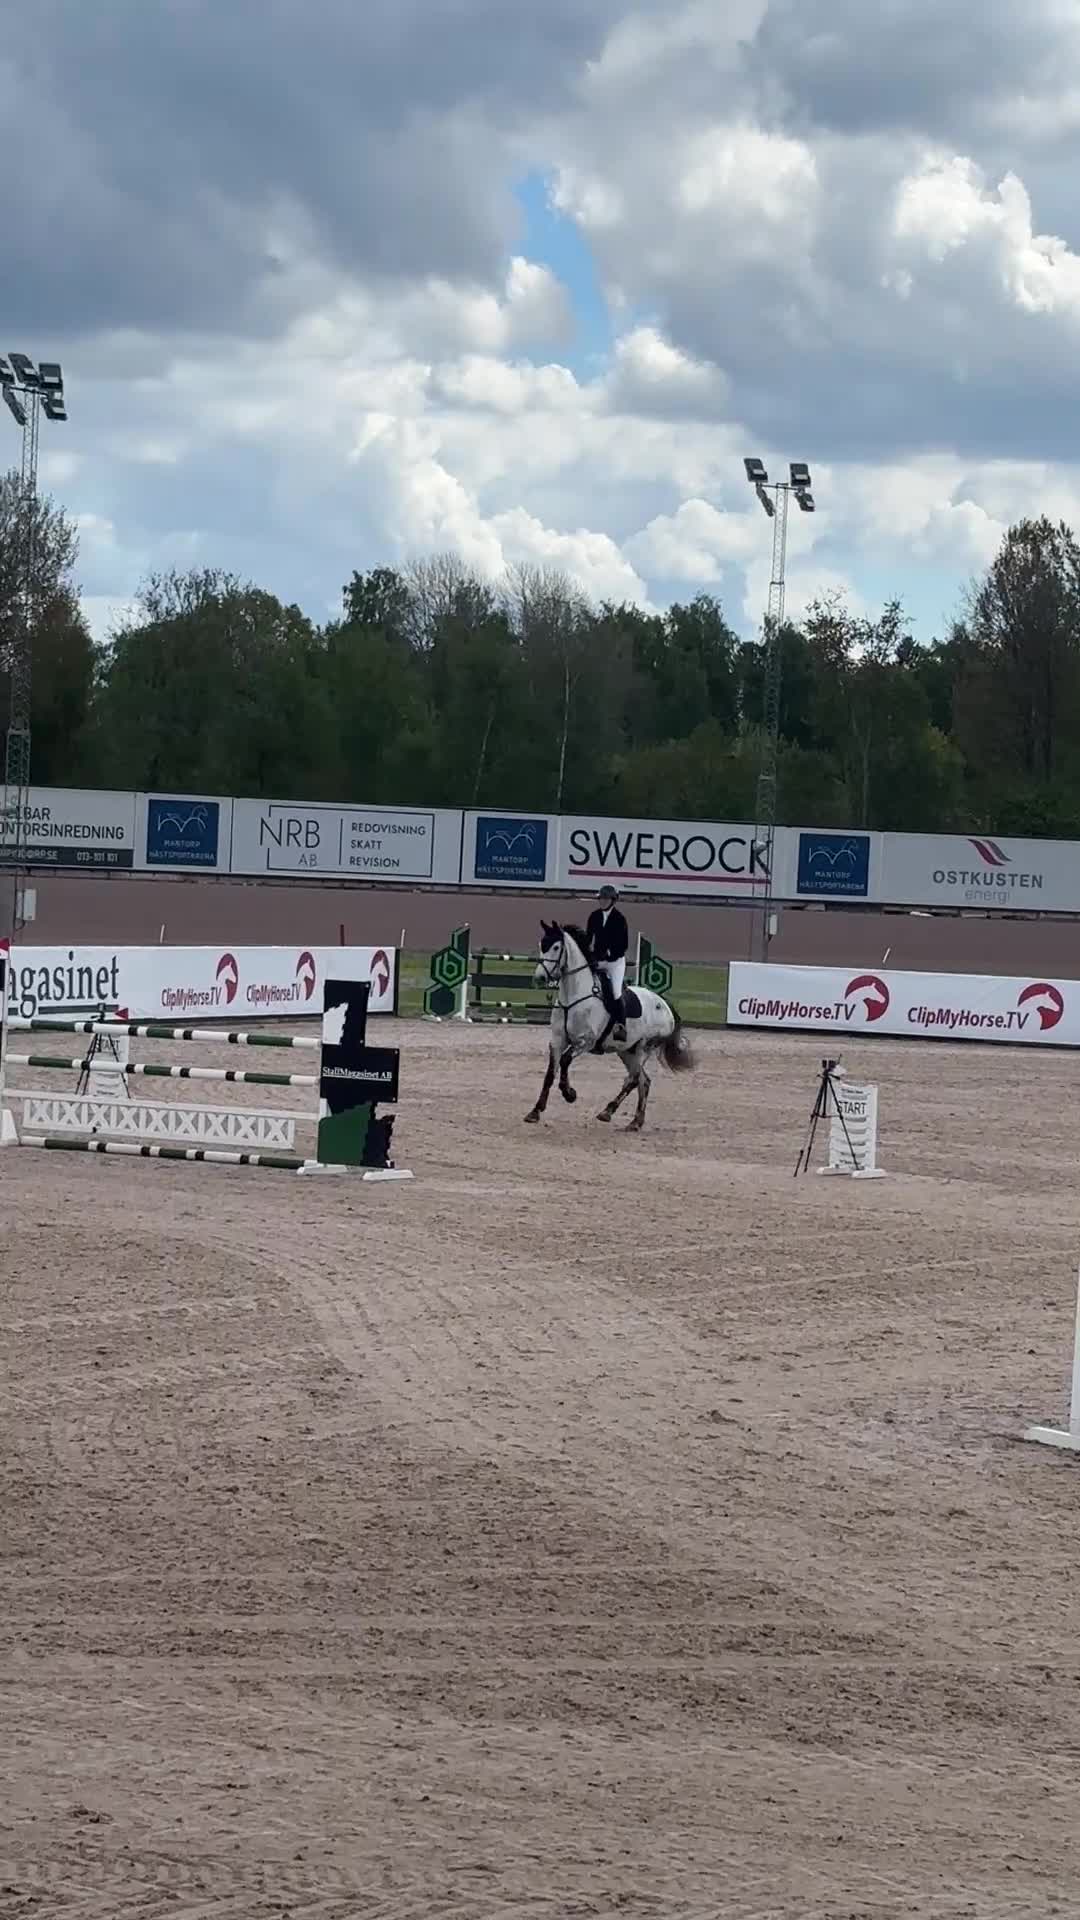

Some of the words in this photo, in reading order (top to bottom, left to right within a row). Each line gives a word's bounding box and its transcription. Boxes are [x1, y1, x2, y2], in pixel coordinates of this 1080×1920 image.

[259, 817, 321, 849] NRB
[351, 822, 427, 836] REDOVISNING
[350, 840, 383, 851] SKATT
[568, 829, 772, 875] SWEROCK
[298, 853, 318, 867] AB
[349, 856, 400, 868] REVISION
[932, 870, 1043, 888] OSTKUSTEN
[964, 889, 1011, 905] energi
[161, 986, 223, 1011] ClipMyHorse.TV
[246, 983, 302, 1007] ClipMyHorse.TV
[737, 998, 857, 1022] ClipMyHorse.TV
[907, 1006, 1030, 1030] ClipMyHorse.TV
